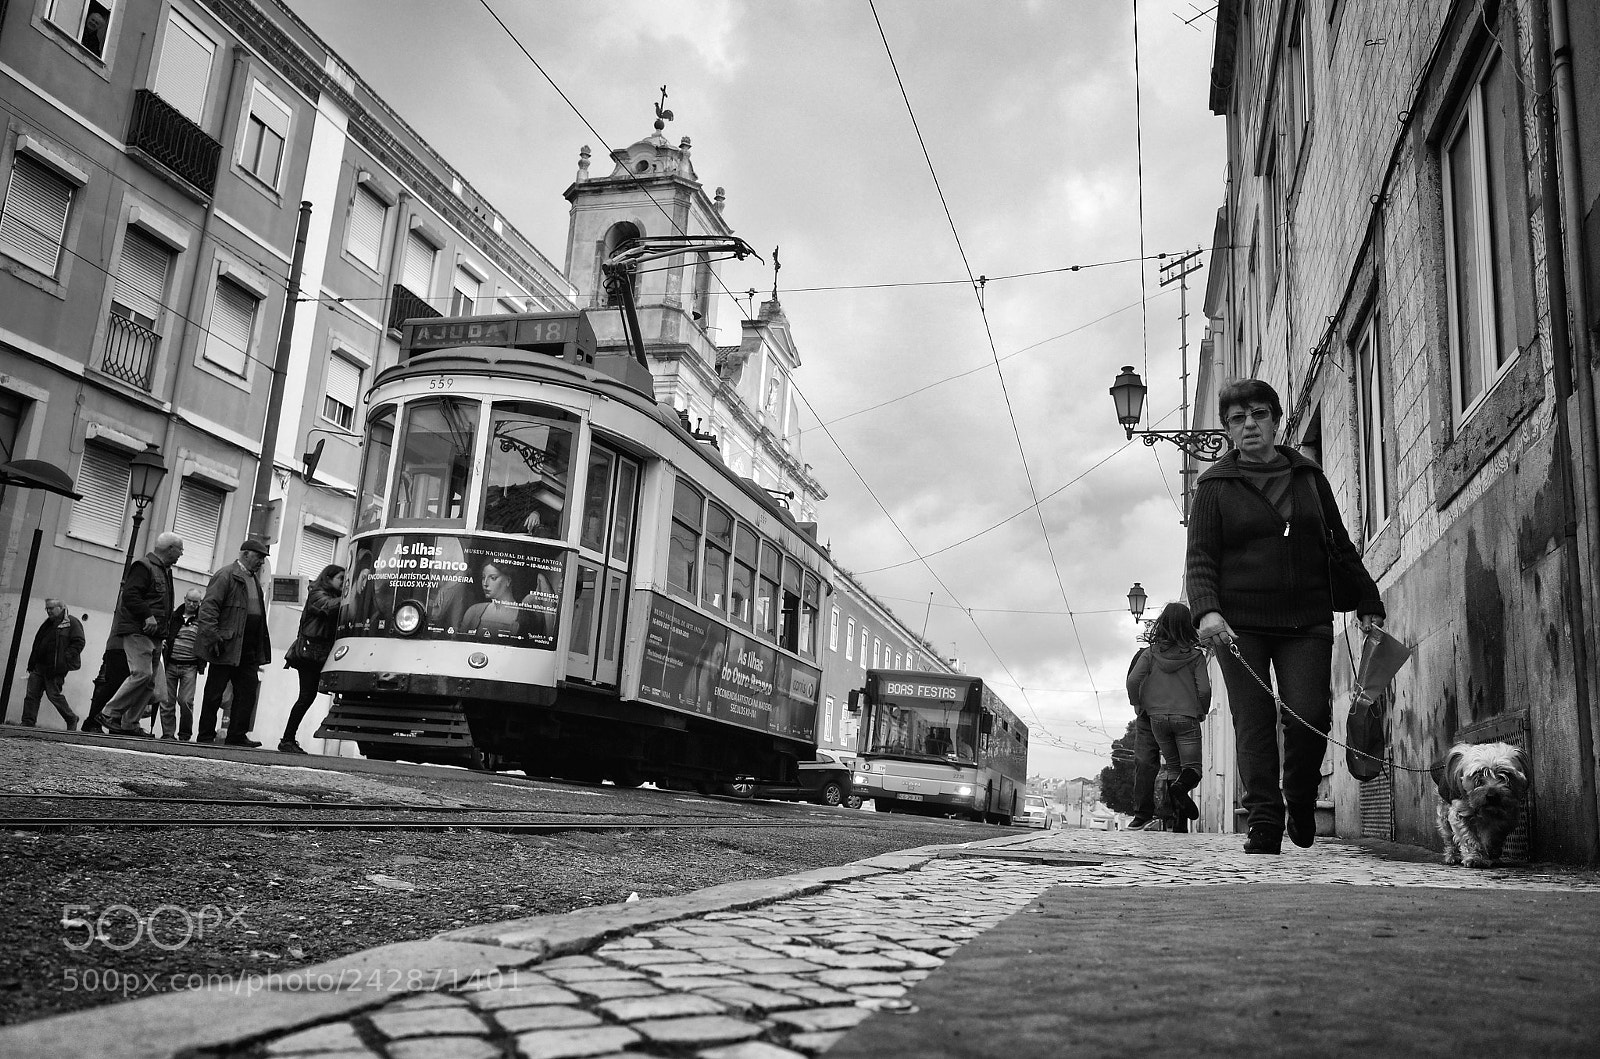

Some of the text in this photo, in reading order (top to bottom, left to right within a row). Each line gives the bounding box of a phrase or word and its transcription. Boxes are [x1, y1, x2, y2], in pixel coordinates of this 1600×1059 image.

[417, 322, 561, 342] AJUDA 18
[429, 377, 454, 390] 559
[394, 542, 443, 556] As Ilhas
[373, 556, 468, 571] do Ouro Branco
[485, 550, 516, 559] NACIONAL
[526, 555, 541, 563] ARTE
[541, 558, 563, 567] ANTIGA
[367, 571, 474, 584] ENCOMENDA ARTÍSTICA NA MADEIRA
[416, 581, 439, 589] XV-XVI
[737, 648, 764, 672] As Ilhas
[721, 661, 732, 681] do
[732, 666, 750, 688] Ouro
[887, 682, 957, 699] BOAS FESTAS
